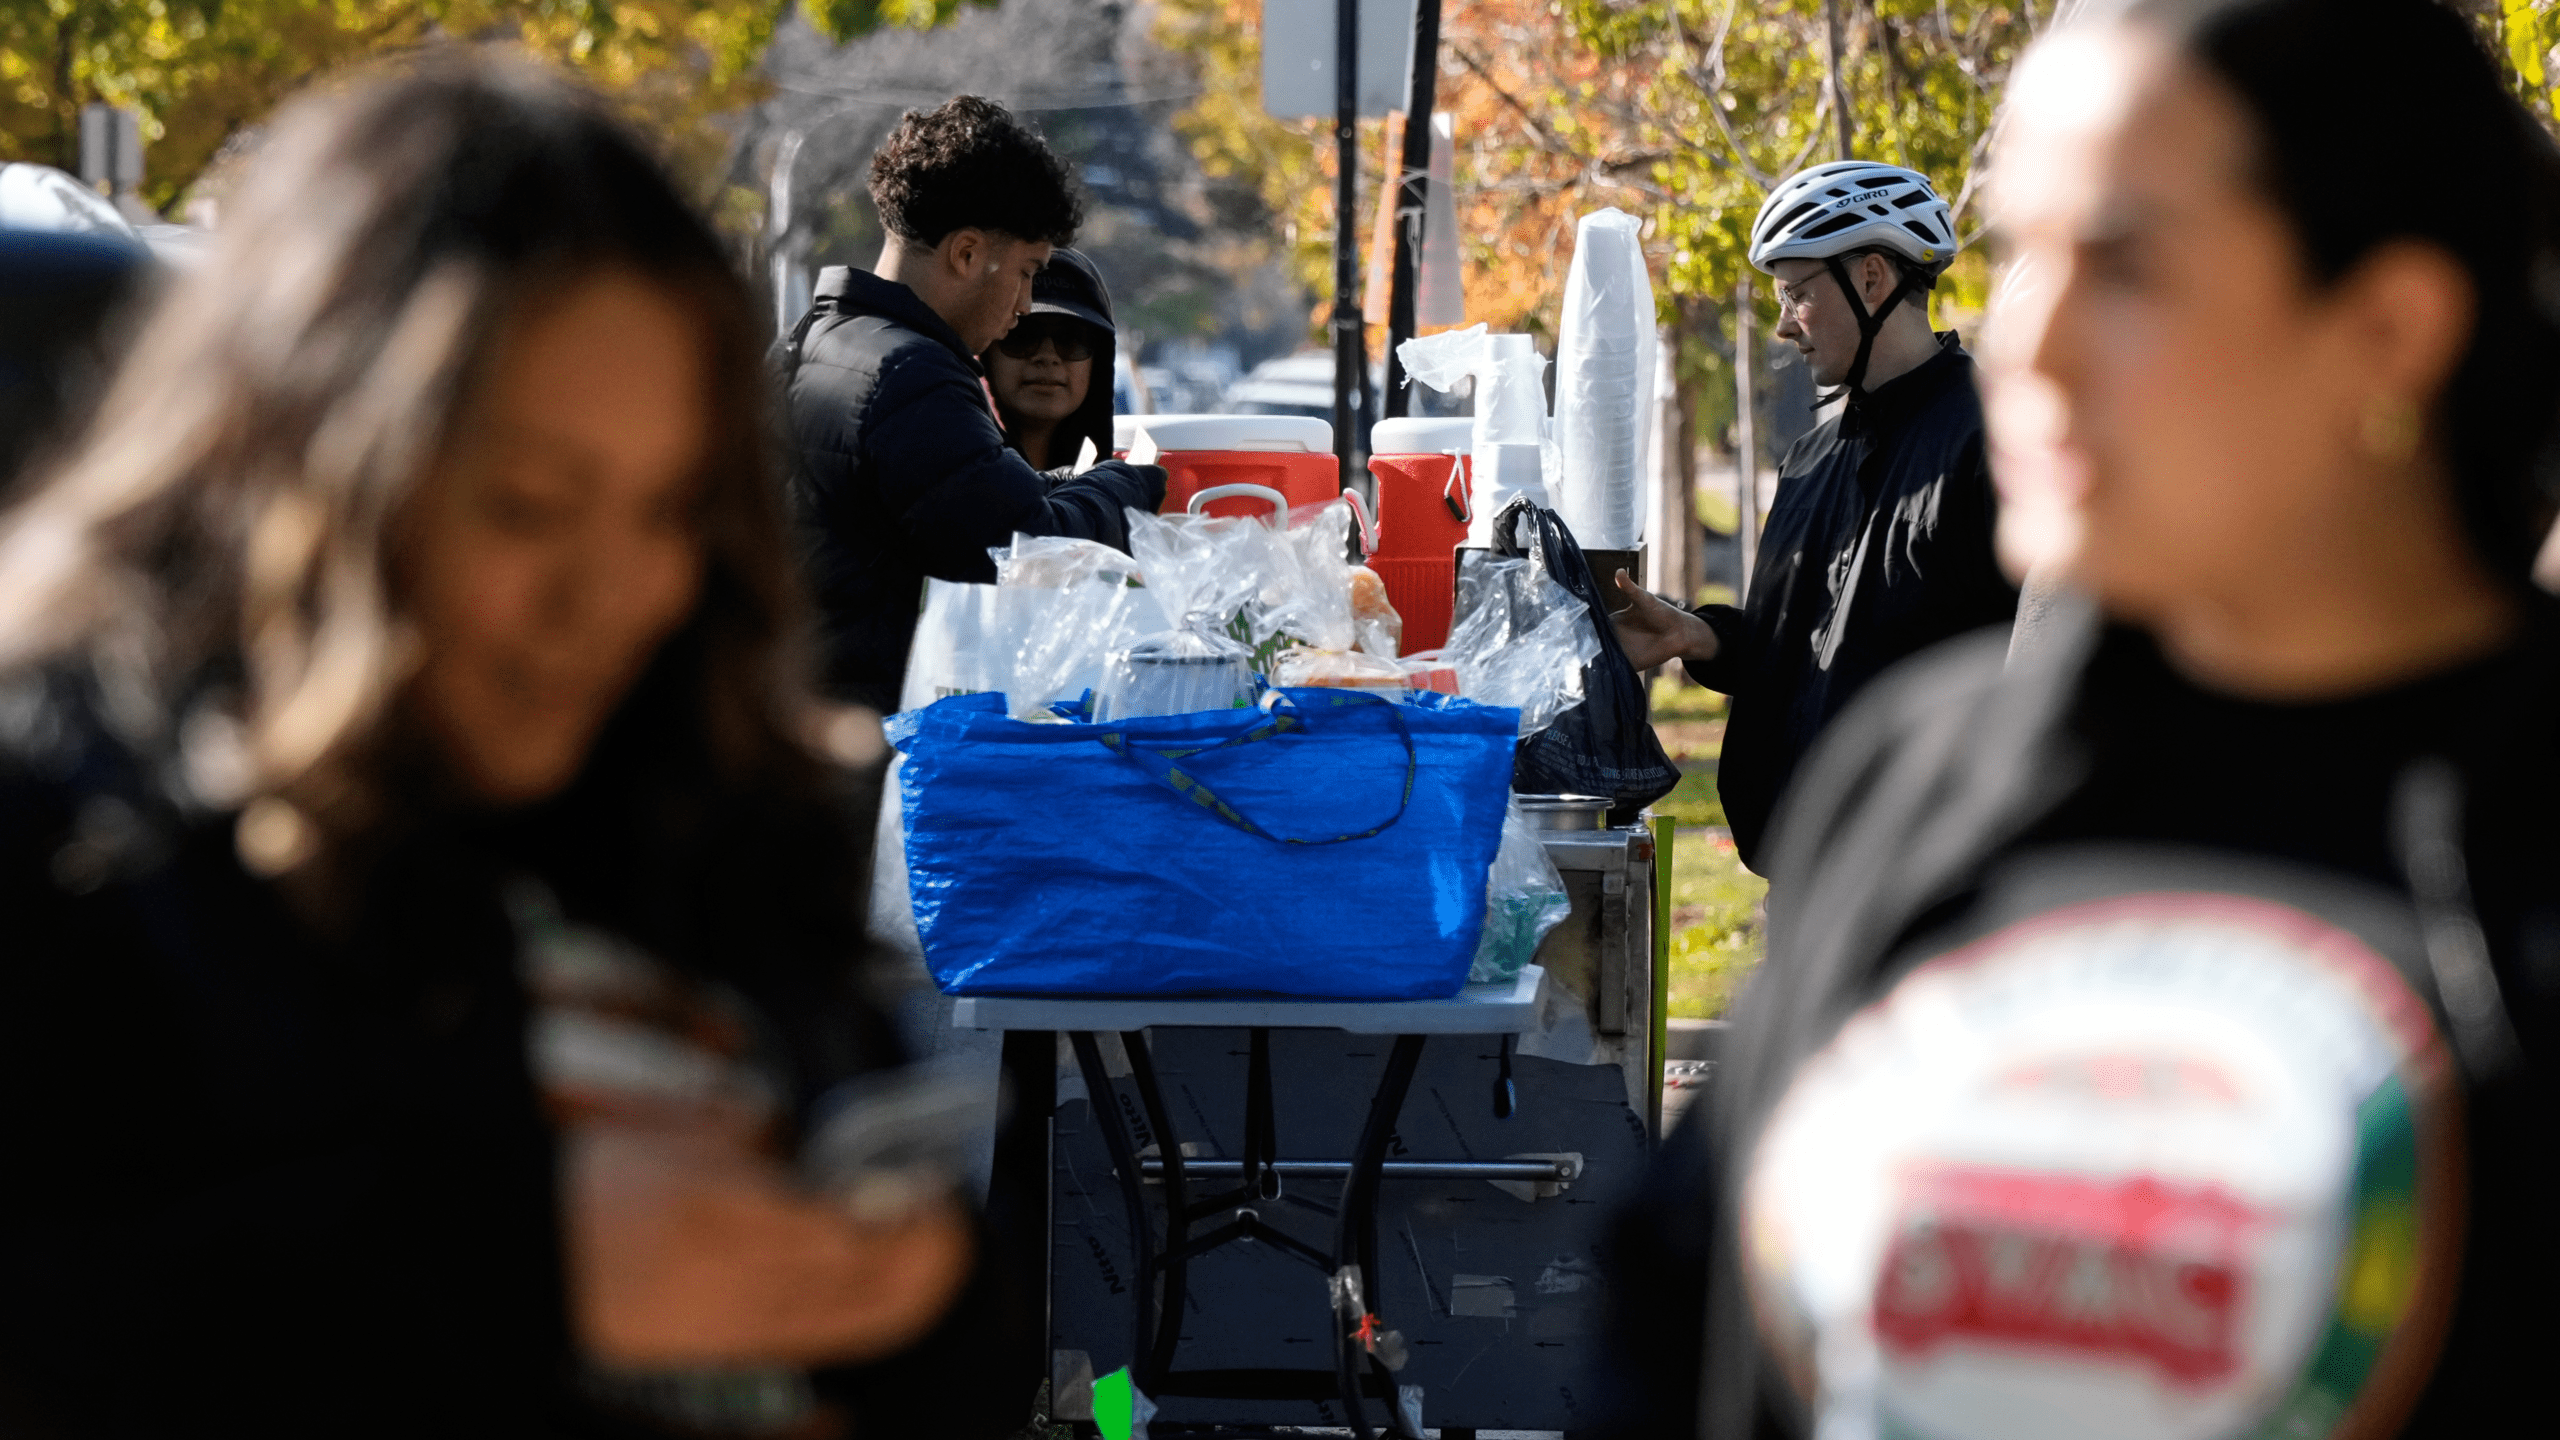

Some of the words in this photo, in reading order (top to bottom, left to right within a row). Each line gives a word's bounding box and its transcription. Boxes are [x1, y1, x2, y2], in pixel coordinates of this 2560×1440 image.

[1853, 189, 1889, 203] GIRO
[1543, 728, 1570, 747] PLEASE
[1120, 1093, 1152, 1149] Nitto
[1088, 1236, 1126, 1295] Nitto
